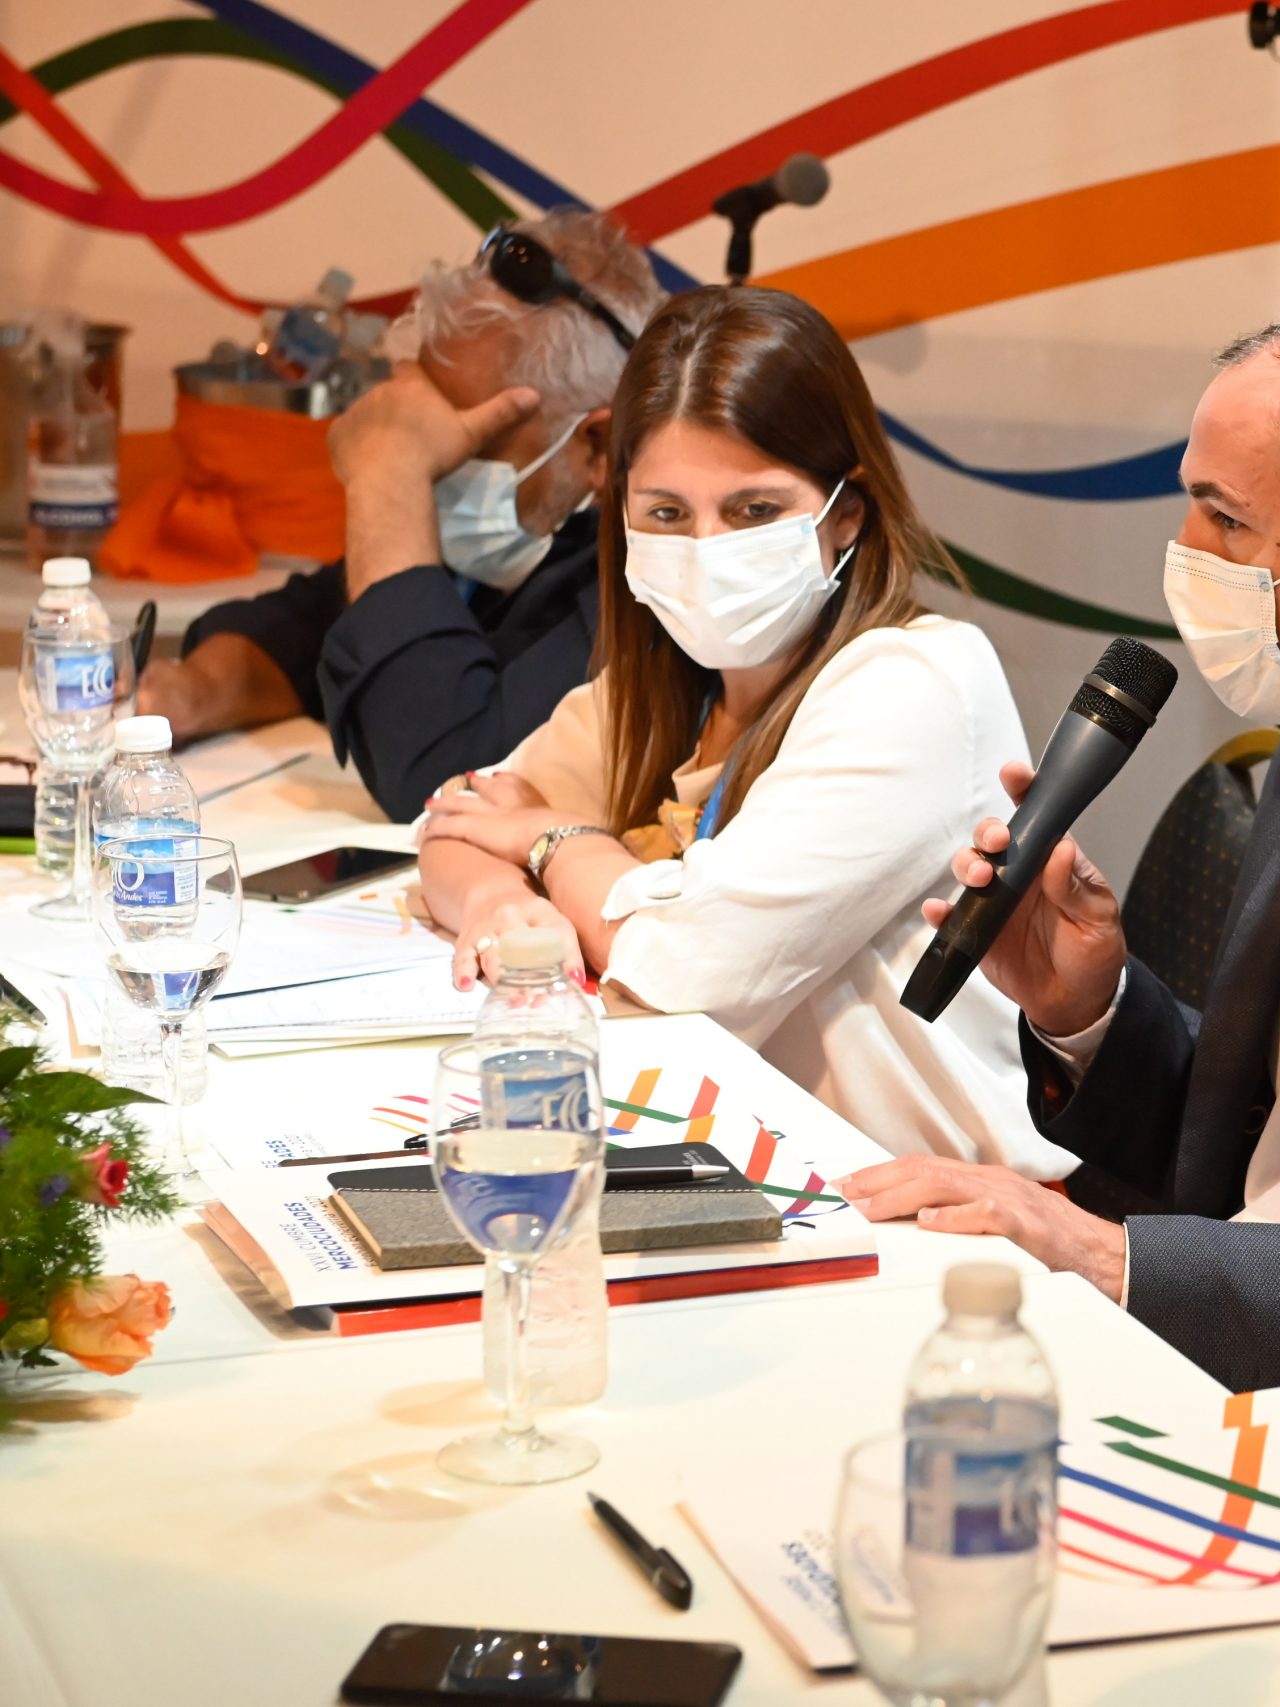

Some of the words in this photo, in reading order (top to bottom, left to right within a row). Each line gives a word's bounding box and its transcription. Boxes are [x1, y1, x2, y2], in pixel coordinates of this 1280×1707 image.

[279, 1223, 317, 1251] CUMBRE
[284, 1202, 358, 1271] MERCOCIUDADES
[306, 1252, 333, 1272] XXVI
